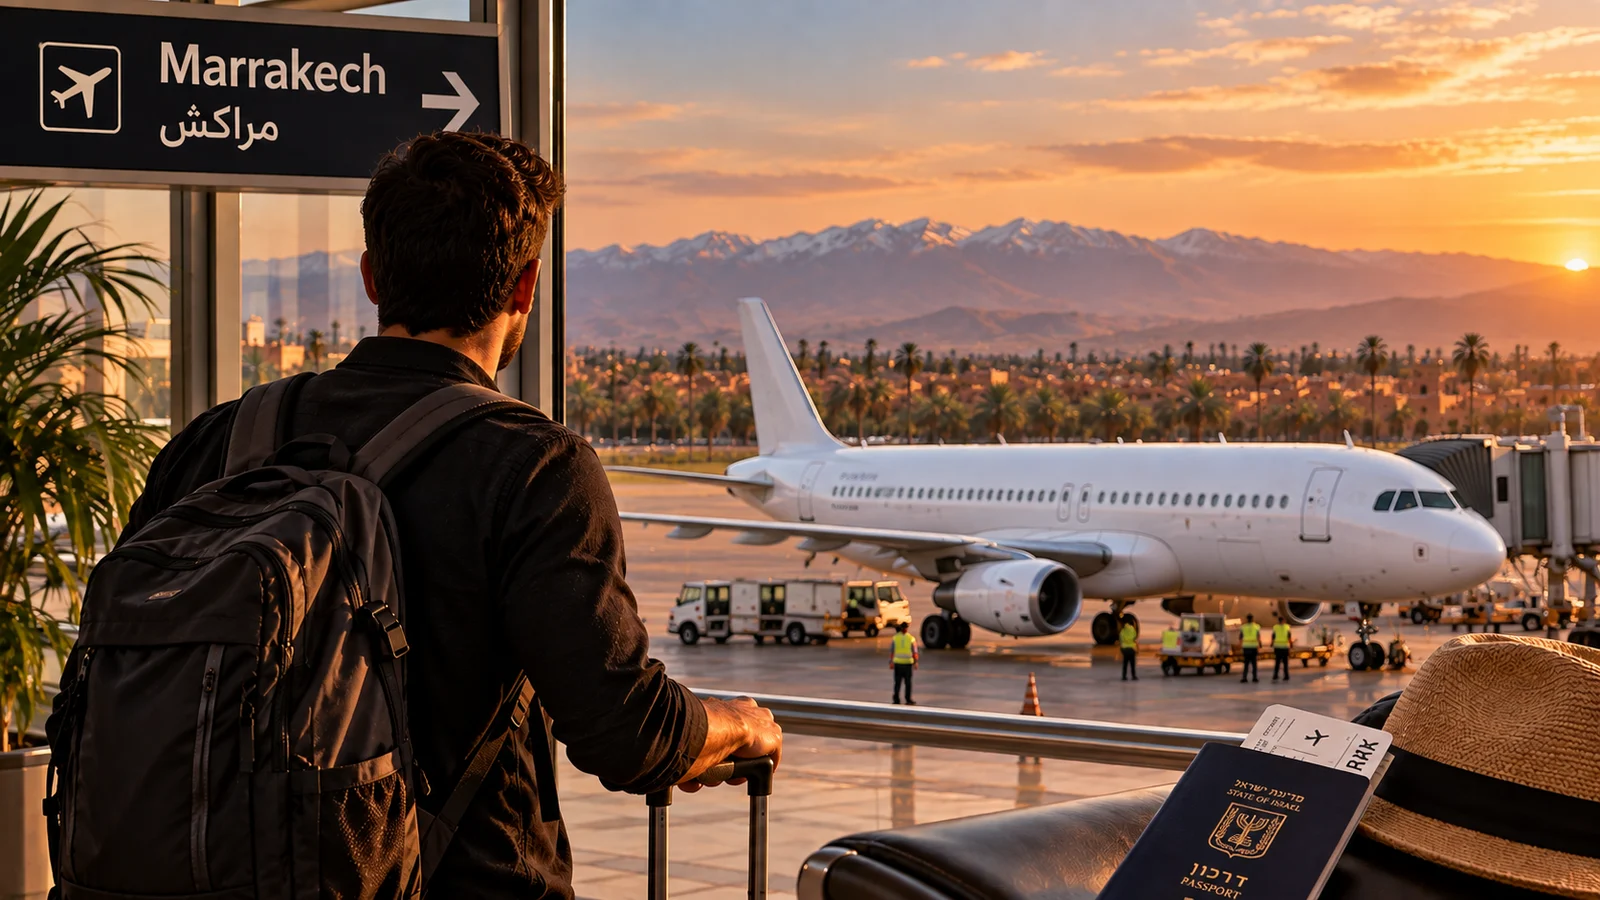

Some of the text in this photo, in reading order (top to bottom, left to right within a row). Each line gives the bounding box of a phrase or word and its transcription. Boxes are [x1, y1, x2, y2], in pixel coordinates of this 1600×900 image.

[160, 41, 386, 95] Marrakech
[159, 104, 279, 151] مراكش
[1226, 788, 1255, 801] STATE
[1255, 795, 1271, 804] OF
[1180, 876, 1242, 900] PASSPORT
[1190, 862, 1249, 888] דרכון
